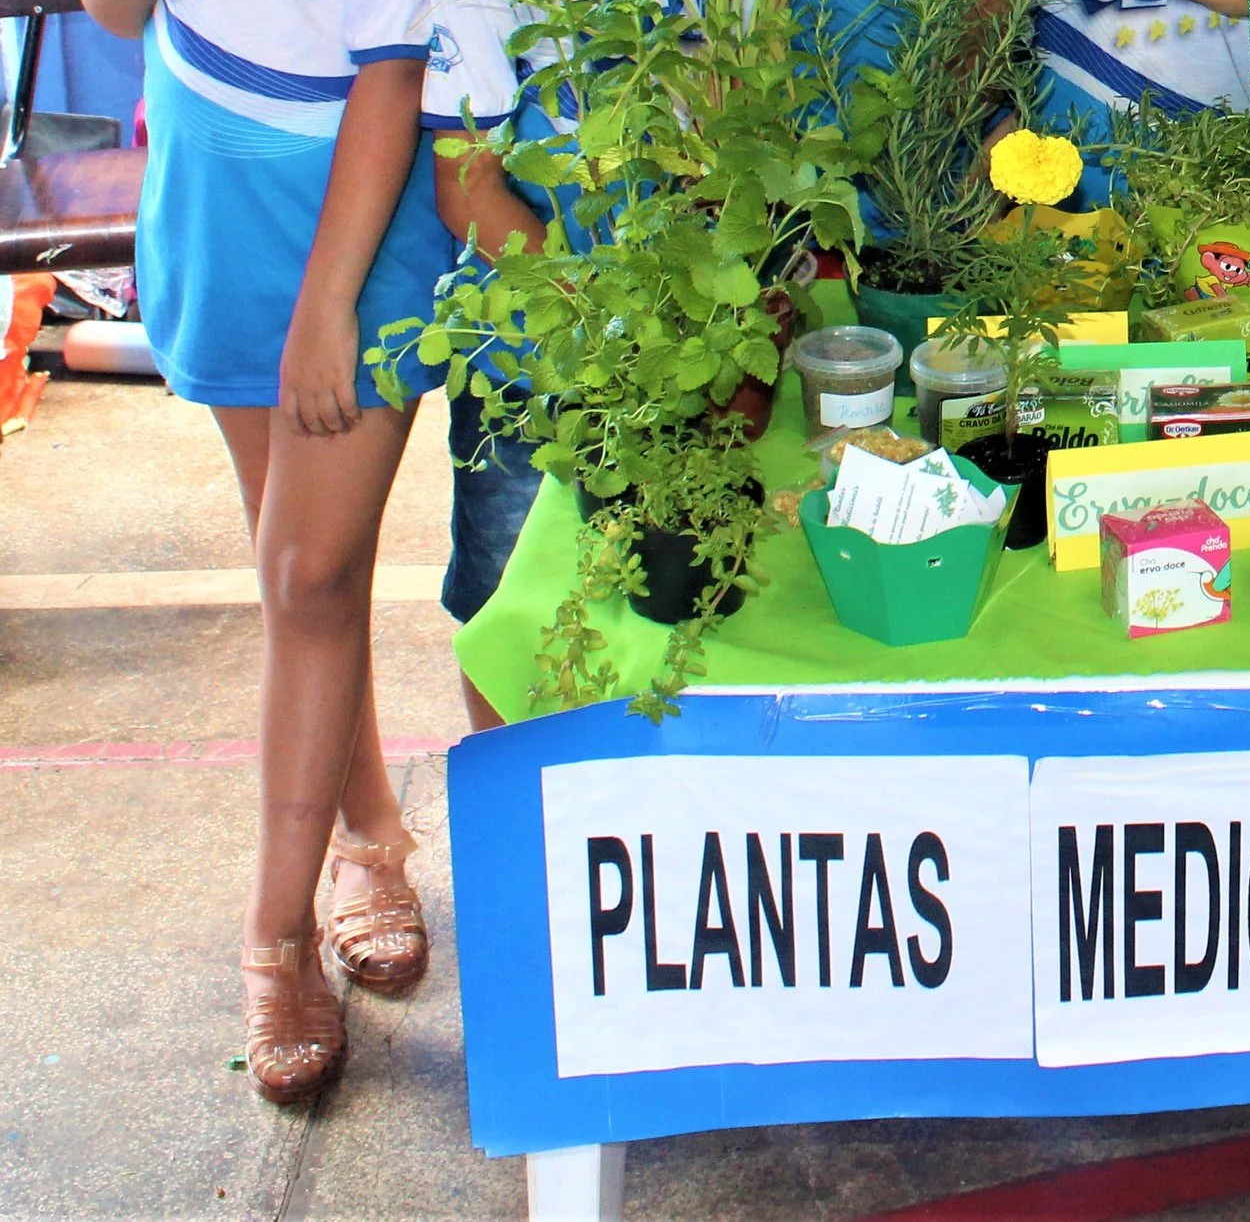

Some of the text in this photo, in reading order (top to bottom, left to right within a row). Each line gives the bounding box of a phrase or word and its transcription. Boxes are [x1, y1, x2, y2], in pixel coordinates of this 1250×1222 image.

[959, 419, 990, 428] CRAVO
[1201, 541, 1227, 553] Prenda
[587, 831, 954, 996] PLANTAS
